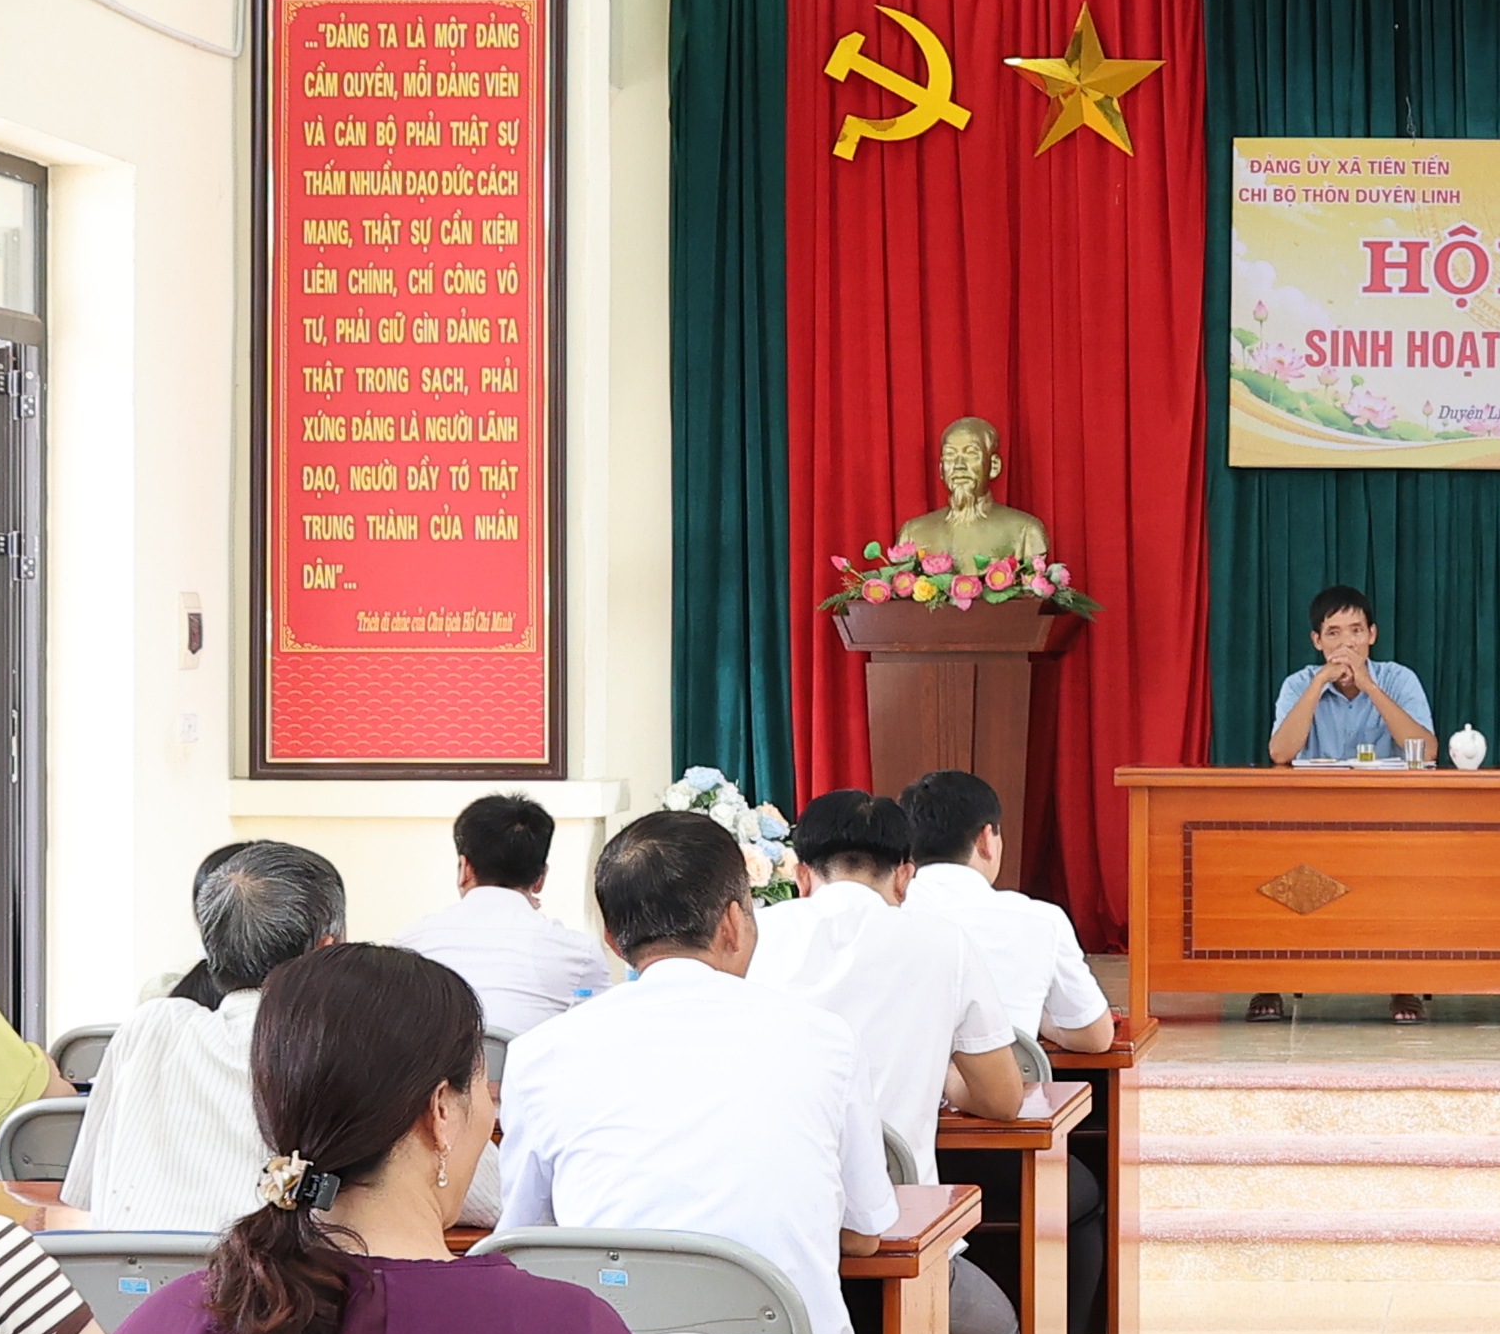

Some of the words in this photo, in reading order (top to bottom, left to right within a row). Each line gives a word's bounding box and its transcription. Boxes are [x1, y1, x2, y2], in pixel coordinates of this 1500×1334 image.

[377, 23, 399, 48] TA
[406, 16, 426, 48] LÀ
[434, 15, 468, 57] MỘT
[475, 12, 520, 49] ĐẢNG
[304, 61, 339, 98] CẦM
[343, 61, 399, 101] QUYỀN,
[403, 59, 432, 98] MỖI
[436, 61, 480, 98] ĐẢNG
[484, 65, 519, 98] VIÊN
[303, 114, 326, 147] VÀ
[334, 114, 367, 147] CÁN
[376, 114, 397, 155] BỘ
[406, 110, 441, 147] PHẢI
[449, 114, 490, 155] THẬT
[497, 118, 520, 155] SỰ
[1250, 154, 1300, 173] ĐẢNG
[1307, 154, 1331, 174] ỦY
[1337, 157, 1362, 174] XÃ
[1368, 157, 1405, 175] TIÊN
[1412, 155, 1450, 175] TIẾN
[1238, 188, 1267, 202] CHI
[1273, 185, 1296, 207] BỘ
[1302, 185, 1349, 203] THÔN
[1355, 186, 1416, 203] DUYÊN
[1422, 189, 1461, 204] LINH
[303, 219, 353, 253] MẠNG,
[361, 212, 402, 253] THẬT
[410, 216, 433, 253] SỰ
[440, 208, 473, 245] CẦN
[482, 212, 519, 253] KIỆM
[303, 261, 338, 294] LIÊM
[347, 261, 398, 298] CHÍNH,
[408, 261, 434, 295] CHÍ
[443, 261, 487, 295] CÔNG
[496, 262, 519, 295] VÔ
[302, 315, 328, 347] TƯ,
[335, 307, 371, 344] PHẢI
[378, 311, 406, 344] GIỮ
[412, 311, 439, 344] GÌN
[446, 307, 491, 344] ĐẢNG
[497, 318, 519, 344] TA
[1305, 329, 1393, 369] SINH
[1407, 331, 1500, 378] HOẠT
[302, 360, 345, 401] THẬT
[355, 366, 409, 393] TRONG
[421, 367, 469, 401] SẠCH,
[481, 356, 519, 393] PHẢI
[1438, 405, 1483, 423] Duyên
[302, 465, 340, 499] ĐẠO,
[350, 458, 398, 491] NGƯỜI
[406, 455, 440, 491] ĐẦY
[448, 458, 470, 492] TỚ
[479, 459, 519, 499] THẬT
[302, 514, 355, 541] TRUNG
[366, 508, 418, 540] THÀNH
[430, 504, 463, 541] CỦA
[474, 508, 519, 541] NHÂN
